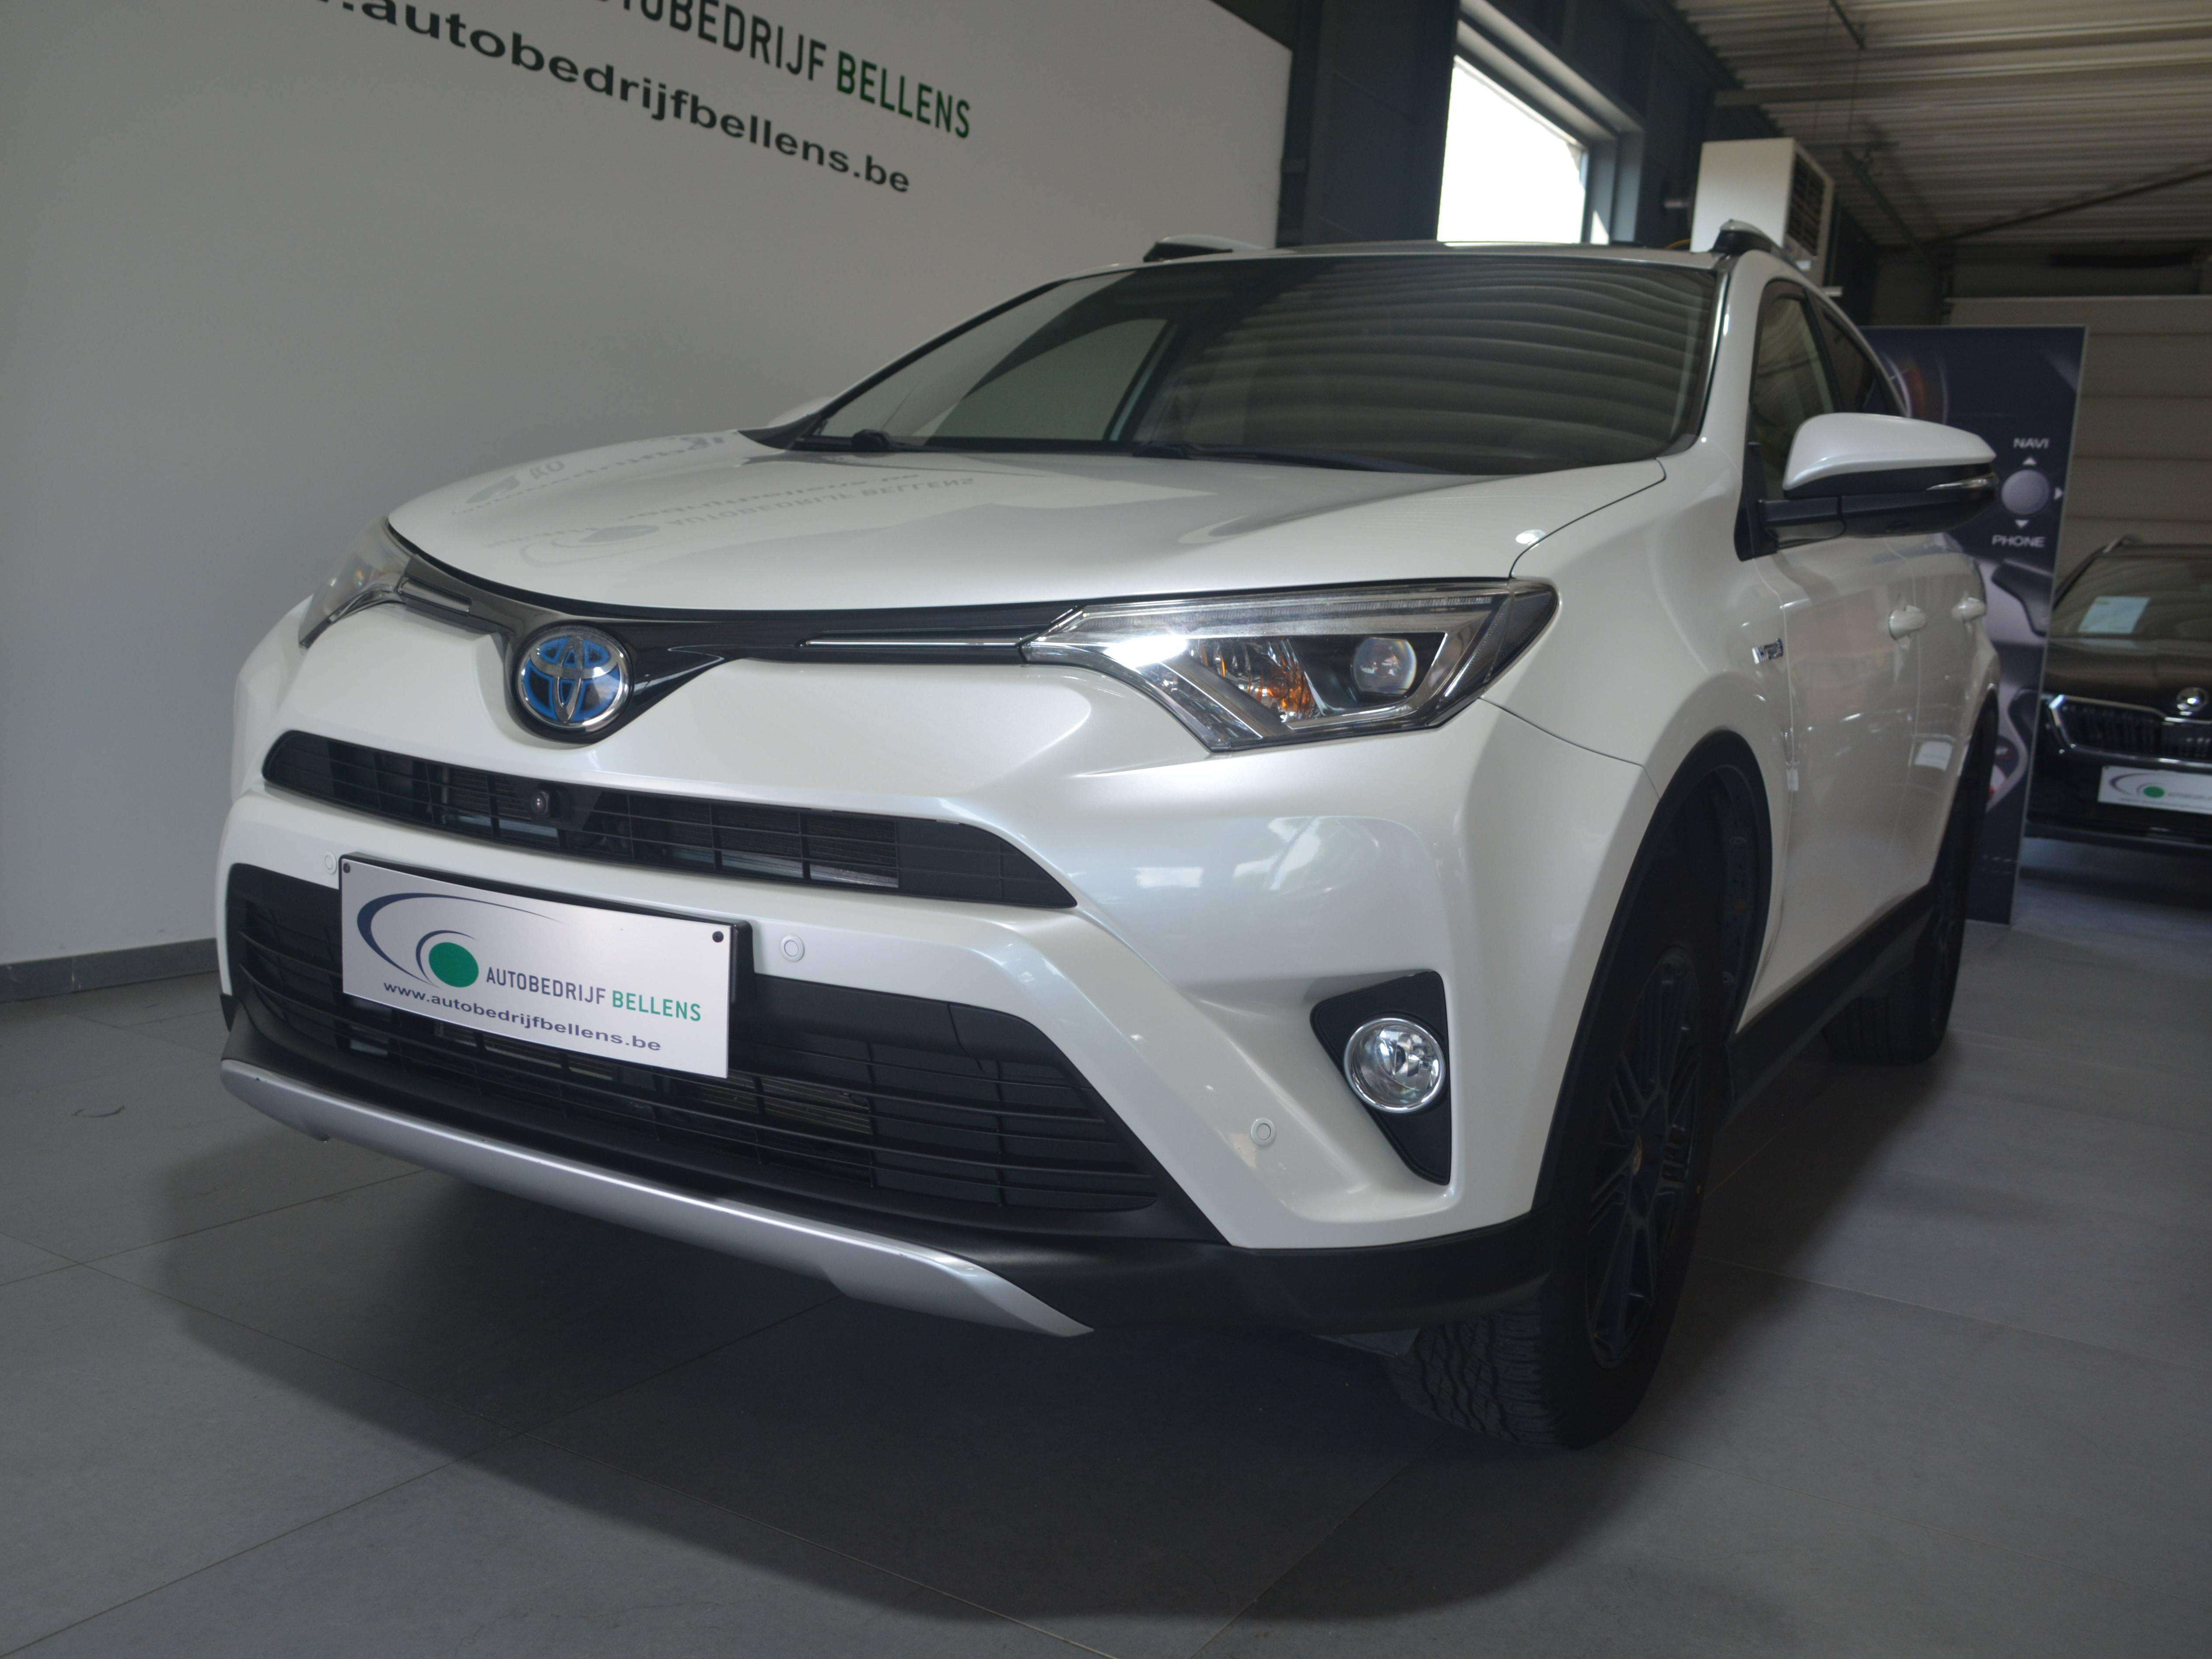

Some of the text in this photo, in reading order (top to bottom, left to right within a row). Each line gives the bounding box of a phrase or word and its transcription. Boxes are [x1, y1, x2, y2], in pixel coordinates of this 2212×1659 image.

[318, 0, 910, 193] .autobedrijfbellens.be
[622, 0, 971, 139] BEDRIJF BELLENS
[2013, 437, 2050, 449] NAVI
[1991, 534, 2046, 548] PHONE
[383, 982, 662, 1051] www.autobedrijfbellens.be
[485, 966, 701, 1022] AUTOBEDRIJF BELLENS
